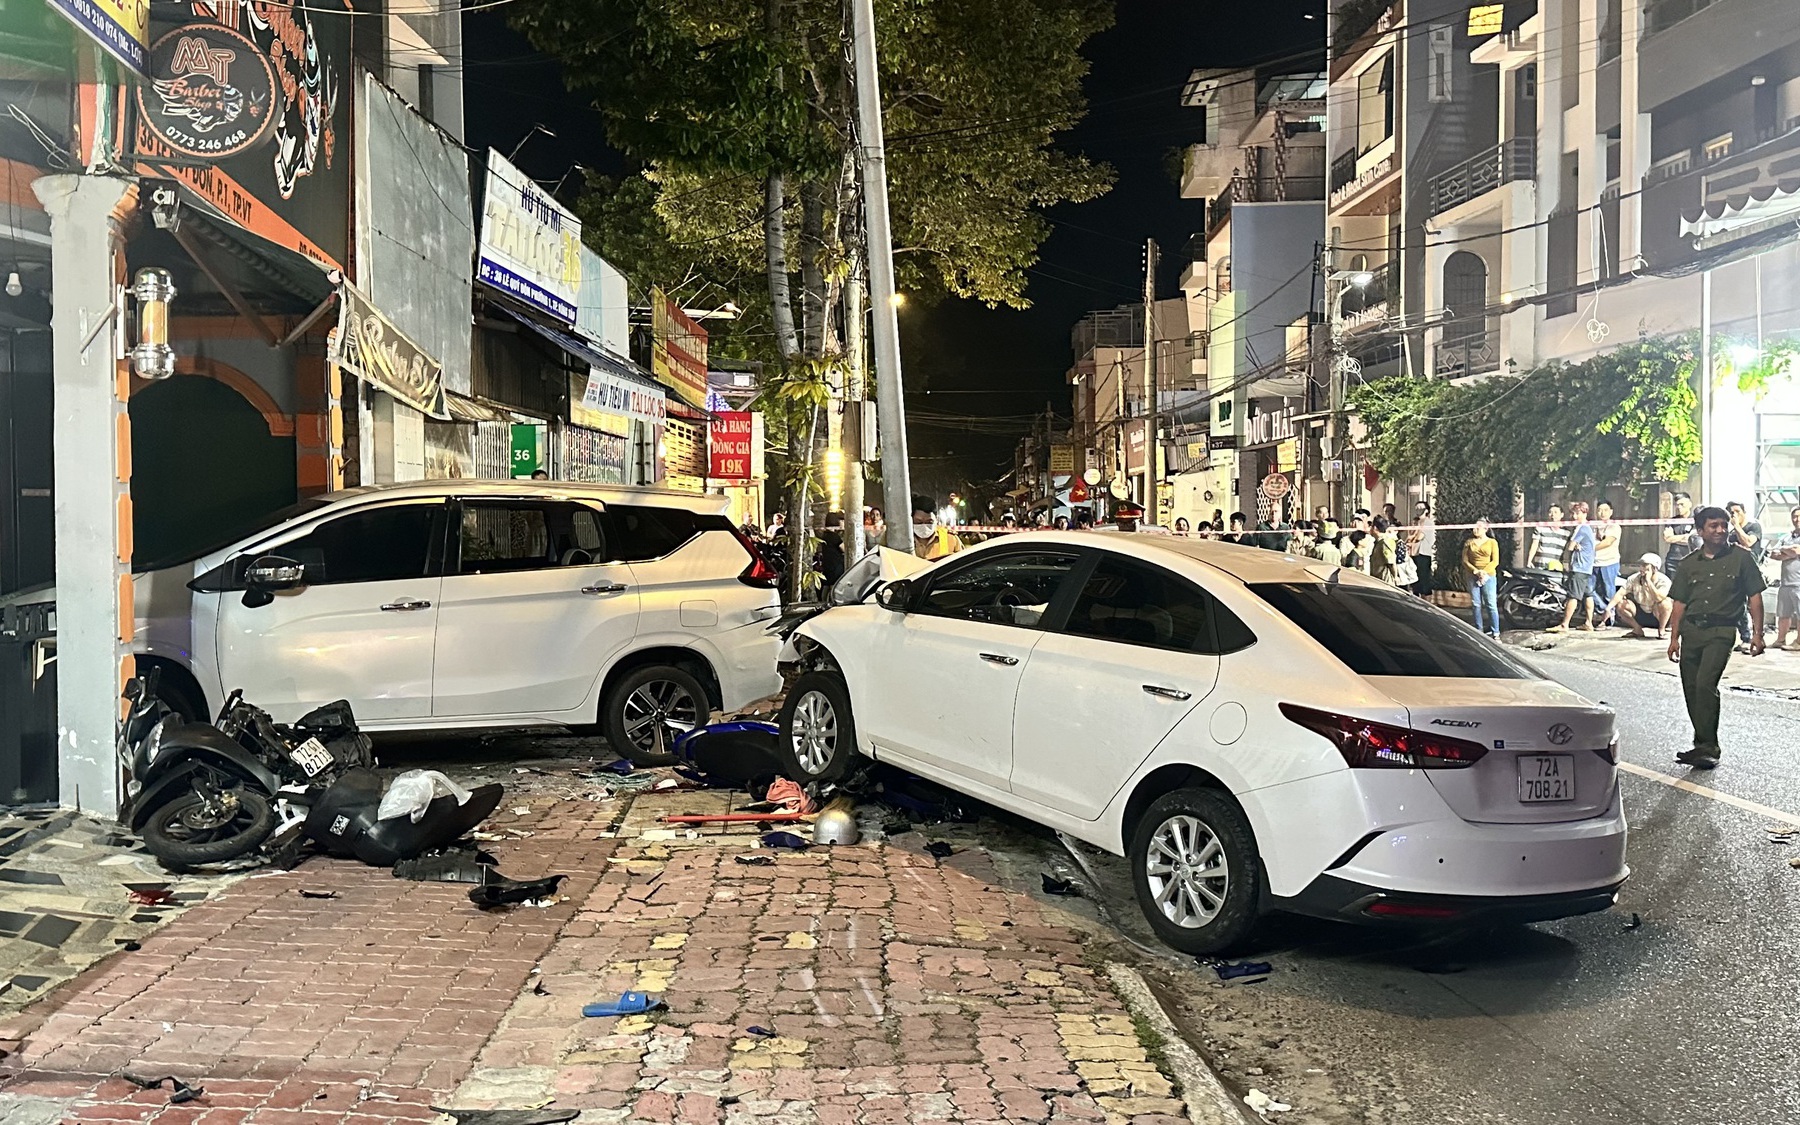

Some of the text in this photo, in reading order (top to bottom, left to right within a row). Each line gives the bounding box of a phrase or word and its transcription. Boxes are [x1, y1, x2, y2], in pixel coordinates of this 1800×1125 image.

[91, 8, 105, 31] 210
[105, 21, 118, 42] 074
[171, 36, 236, 86] MT
[169, 79, 221, 98] Barber
[183, 97, 212, 112] Shop
[166, 126, 246, 150] 0773 246 468
[729, 416, 750, 433] HÀNG
[514, 449, 530, 461] 36
[712, 436, 750, 455] ĐỒNG GIÁ
[720, 458, 744, 474] 19K
[1430, 717, 1482, 729] ACCENT
[1536, 758, 1559, 777] 72A
[1526, 779, 1568, 800] 708.21
